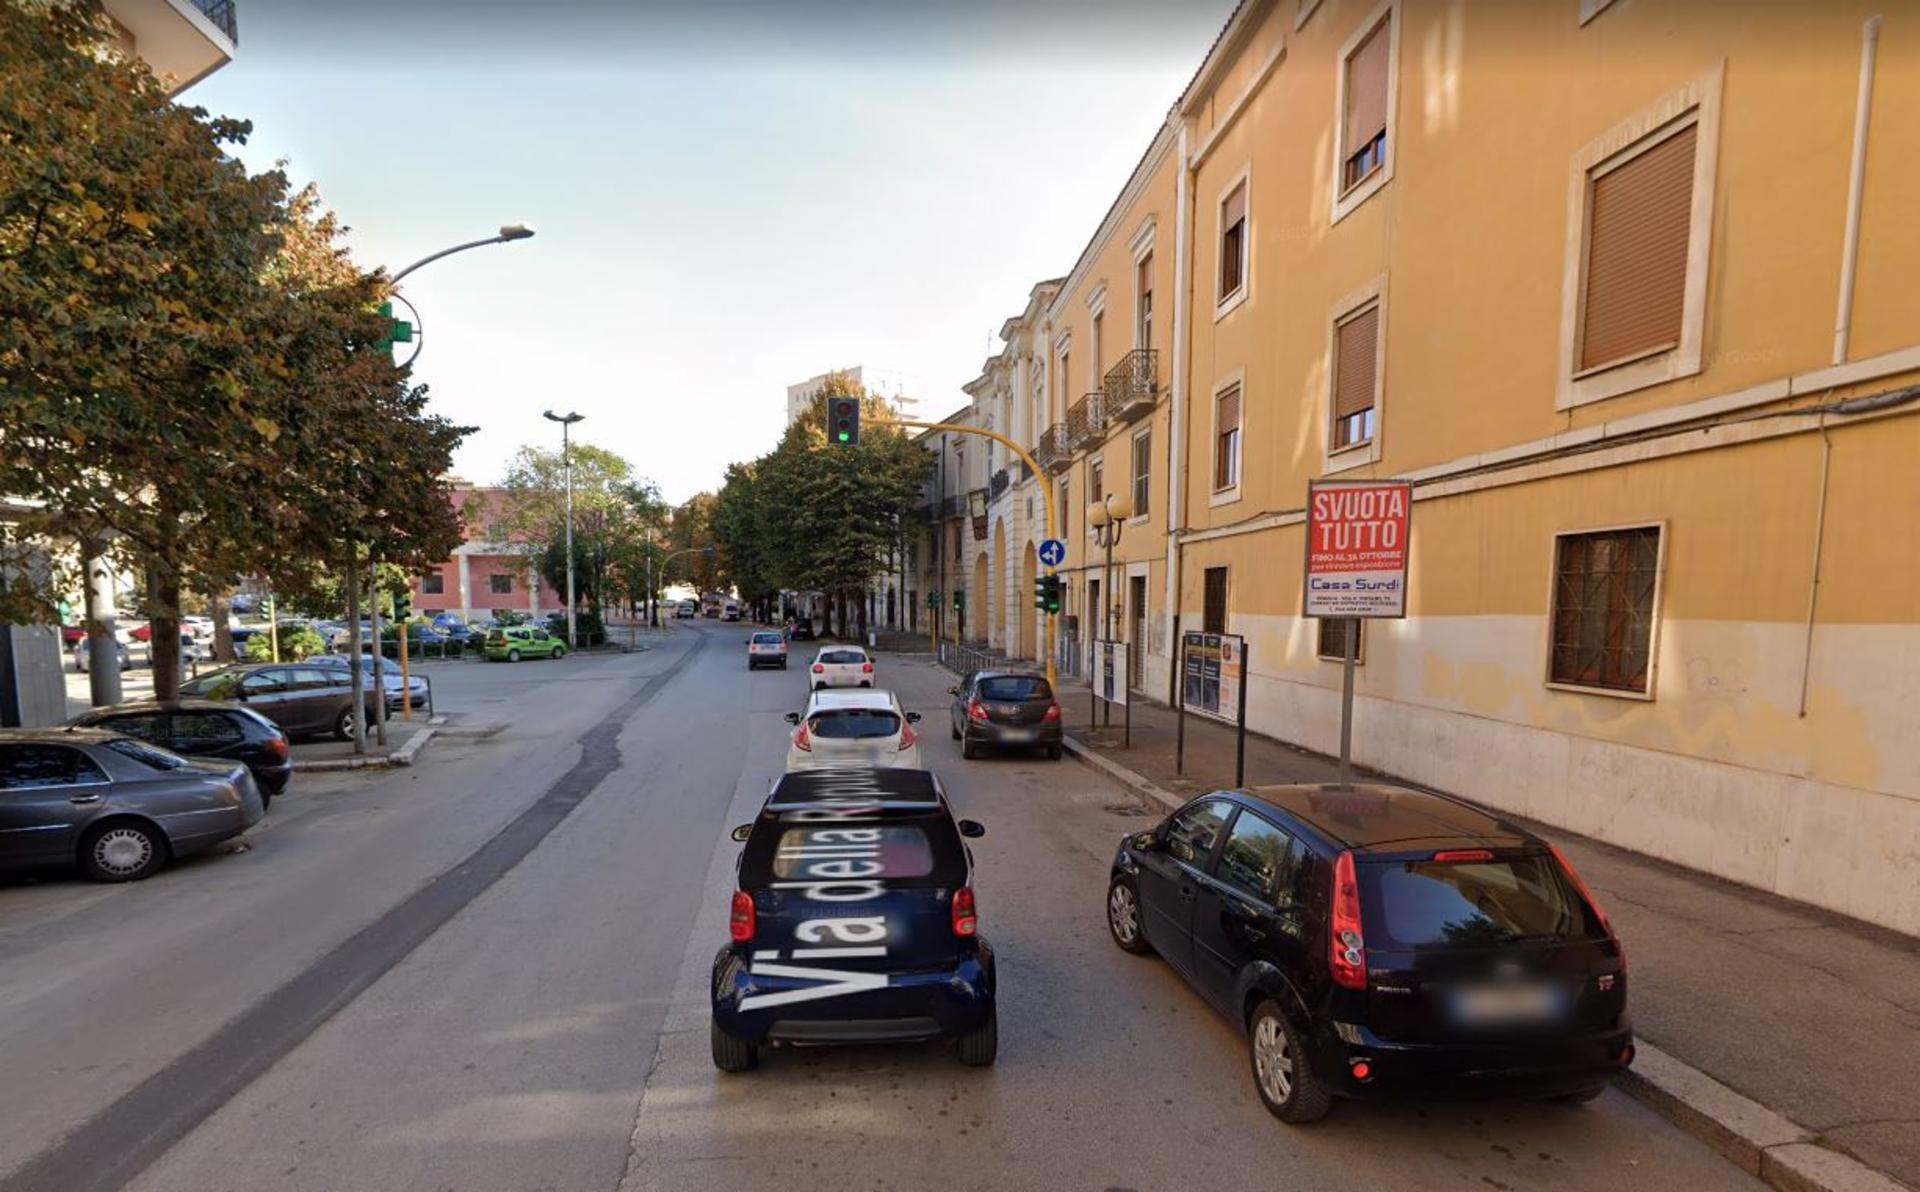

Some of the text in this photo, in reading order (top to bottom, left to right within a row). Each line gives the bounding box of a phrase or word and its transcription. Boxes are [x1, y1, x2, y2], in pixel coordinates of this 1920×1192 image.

[1314, 490, 1403, 520] SVUOTA
[1320, 520, 1397, 550] TUTTO
[1311, 578, 1400, 590] Casa Surdi
